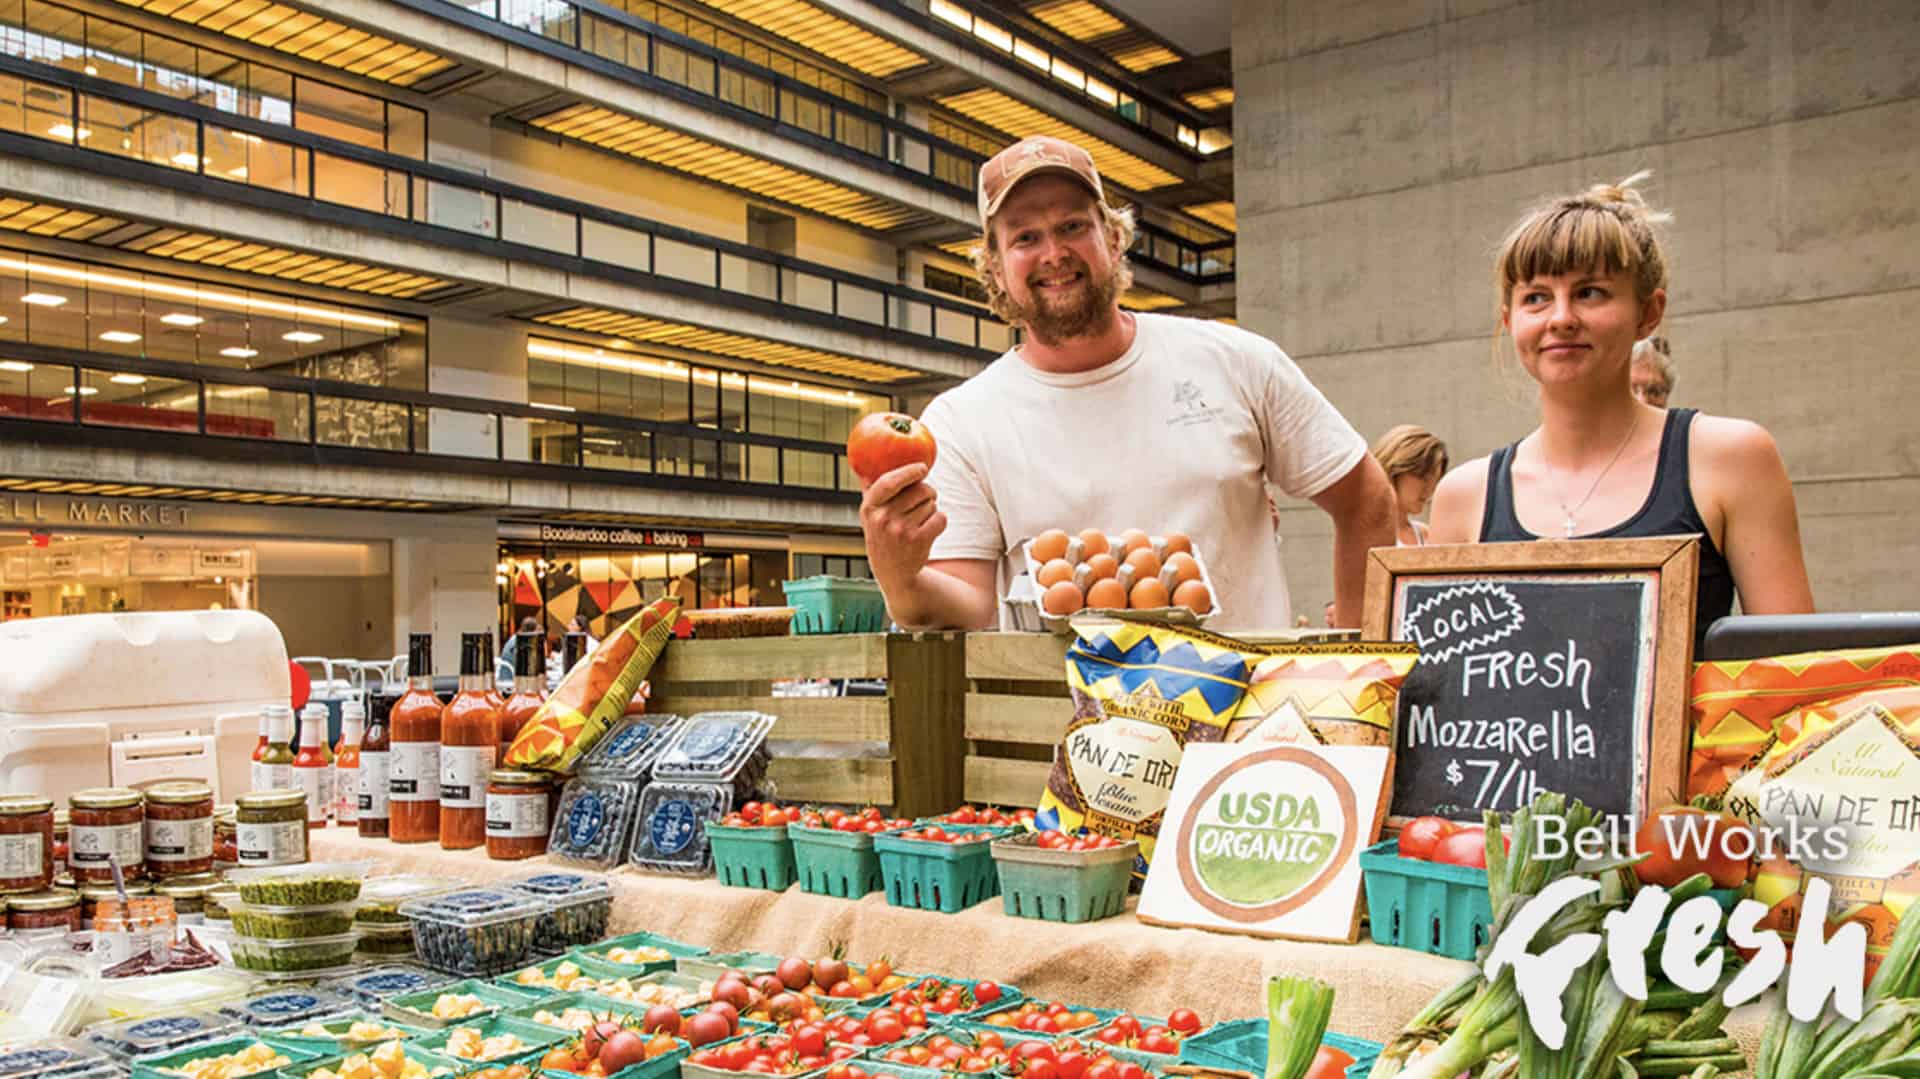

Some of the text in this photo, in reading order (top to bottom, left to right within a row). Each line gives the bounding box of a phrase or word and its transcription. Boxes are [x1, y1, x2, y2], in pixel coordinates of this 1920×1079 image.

[68, 501, 192, 526] MARKET
[609, 529, 643, 545] coffee
[653, 530, 688, 548] baking
[1412, 597, 1508, 648] LOCAL
[1152, 711, 1187, 728] CORN
[1071, 733, 1109, 768] PAN
[1108, 751, 1140, 778] DE
[1142, 758, 1179, 790] OR
[1812, 757, 1906, 779] Natural
[1100, 782, 1138, 803] Blue
[1088, 794, 1142, 819] Sesame
[1217, 790, 1321, 829] USDA
[1765, 786, 1825, 820] PAN
[1833, 794, 1879, 827] DE
[1090, 811, 1133, 832] TORTILLA
[1198, 827, 1325, 864] ORGANIC
